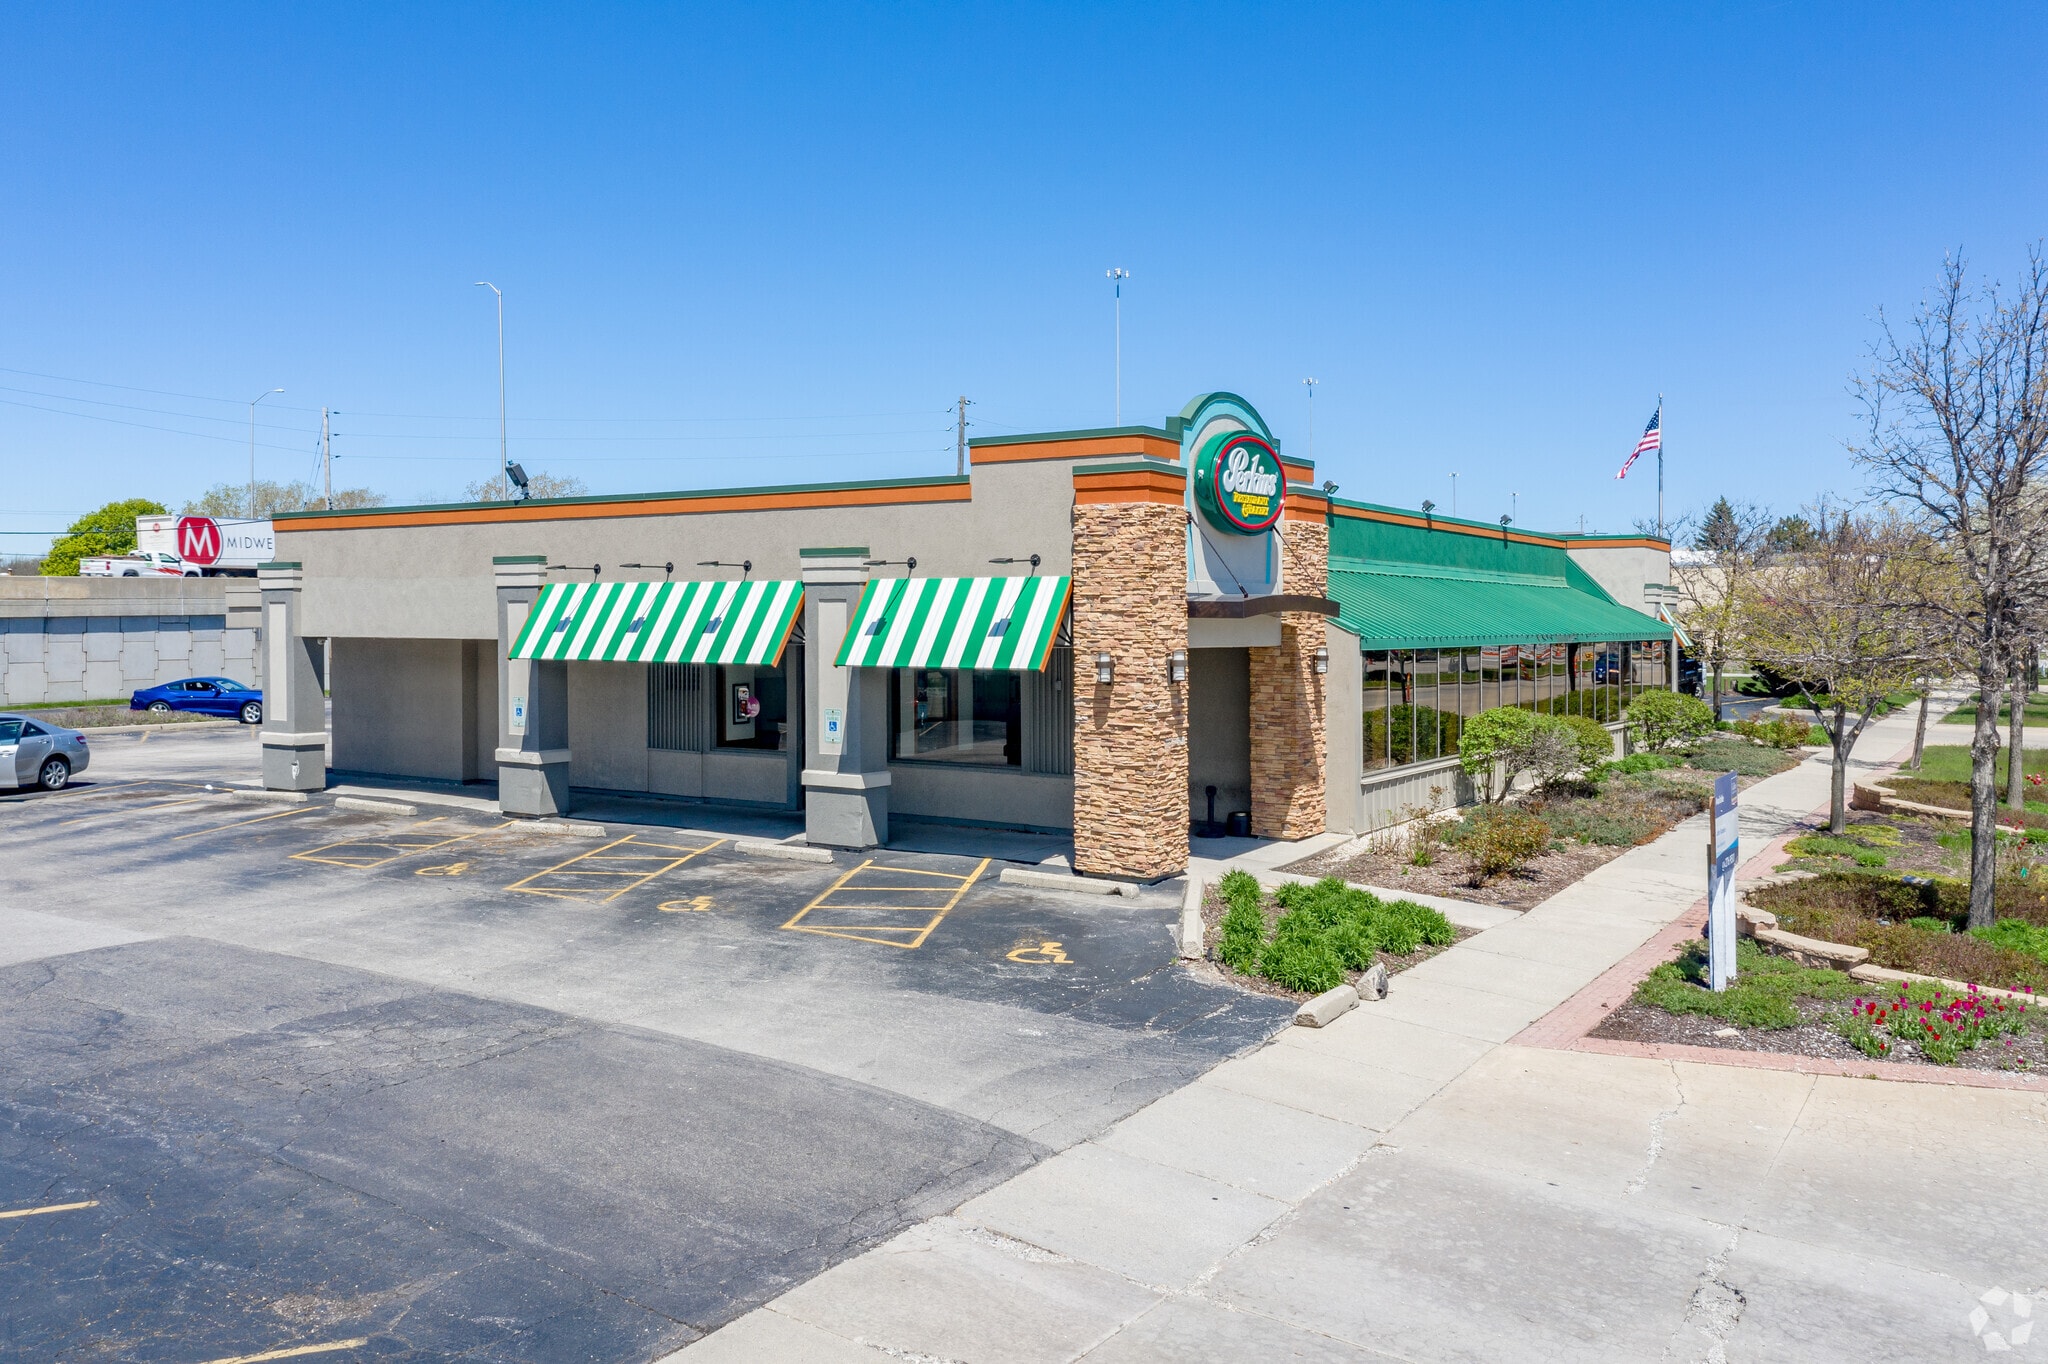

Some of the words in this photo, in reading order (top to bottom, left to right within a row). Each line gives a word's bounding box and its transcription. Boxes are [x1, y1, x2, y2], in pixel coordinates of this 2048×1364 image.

[1223, 447, 1277, 496] Perkins
[183, 522, 215, 557] M
[226, 536, 272, 549] MIDWE
